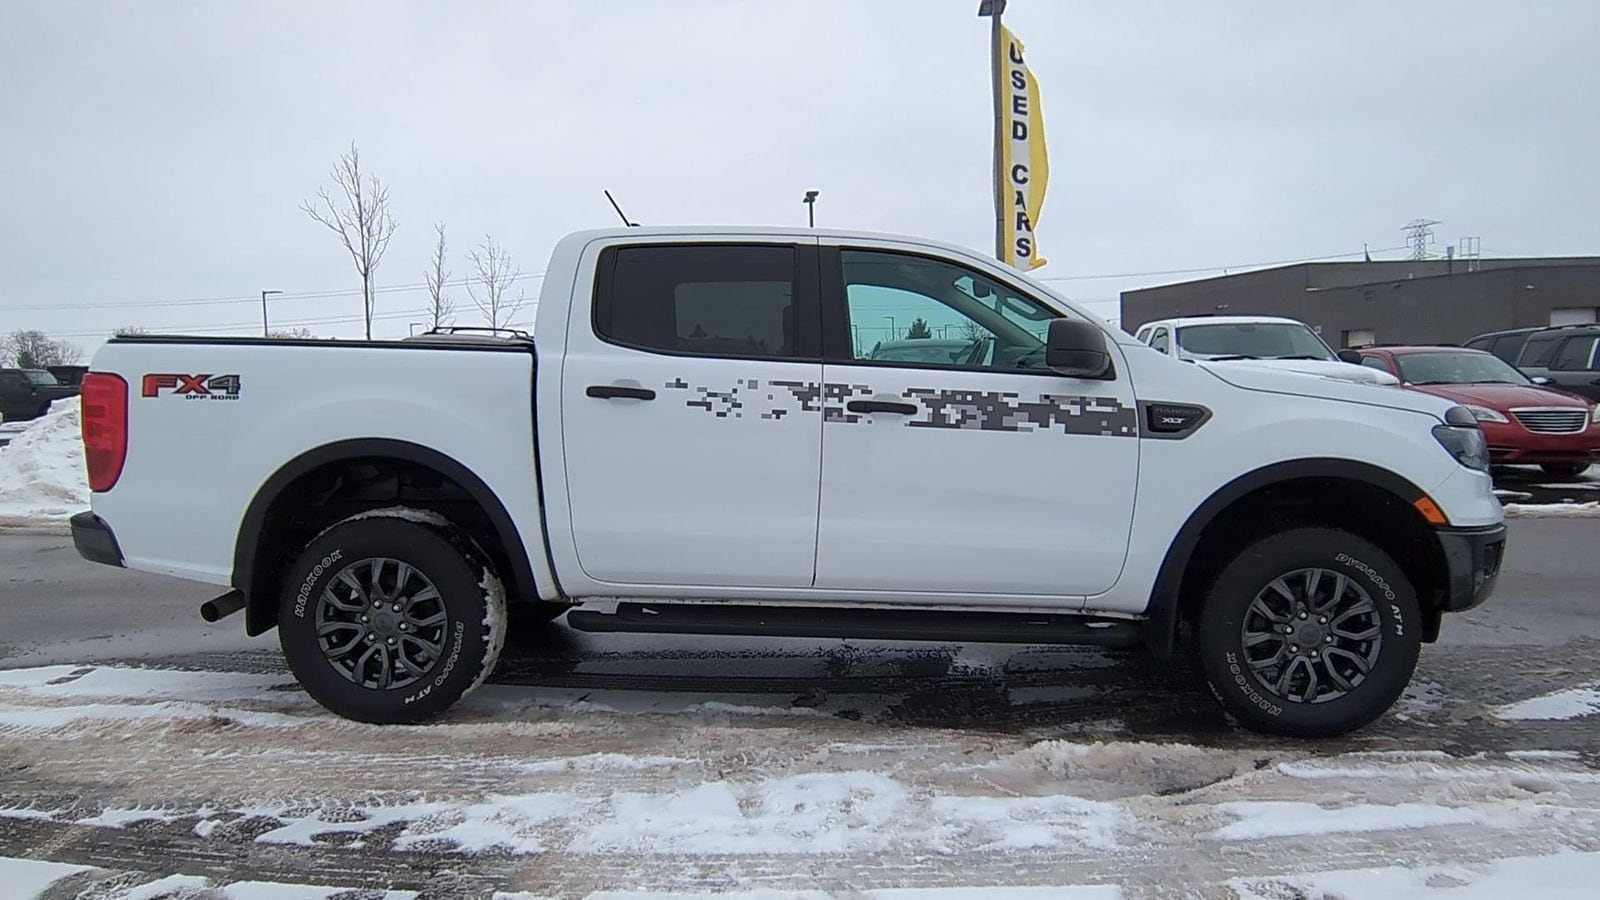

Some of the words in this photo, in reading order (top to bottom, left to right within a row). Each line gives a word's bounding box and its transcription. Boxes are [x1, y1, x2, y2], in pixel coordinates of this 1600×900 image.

[1009, 41, 1027, 141] USED
[1011, 164, 1032, 258] CARS
[142, 373, 240, 397] FX4
